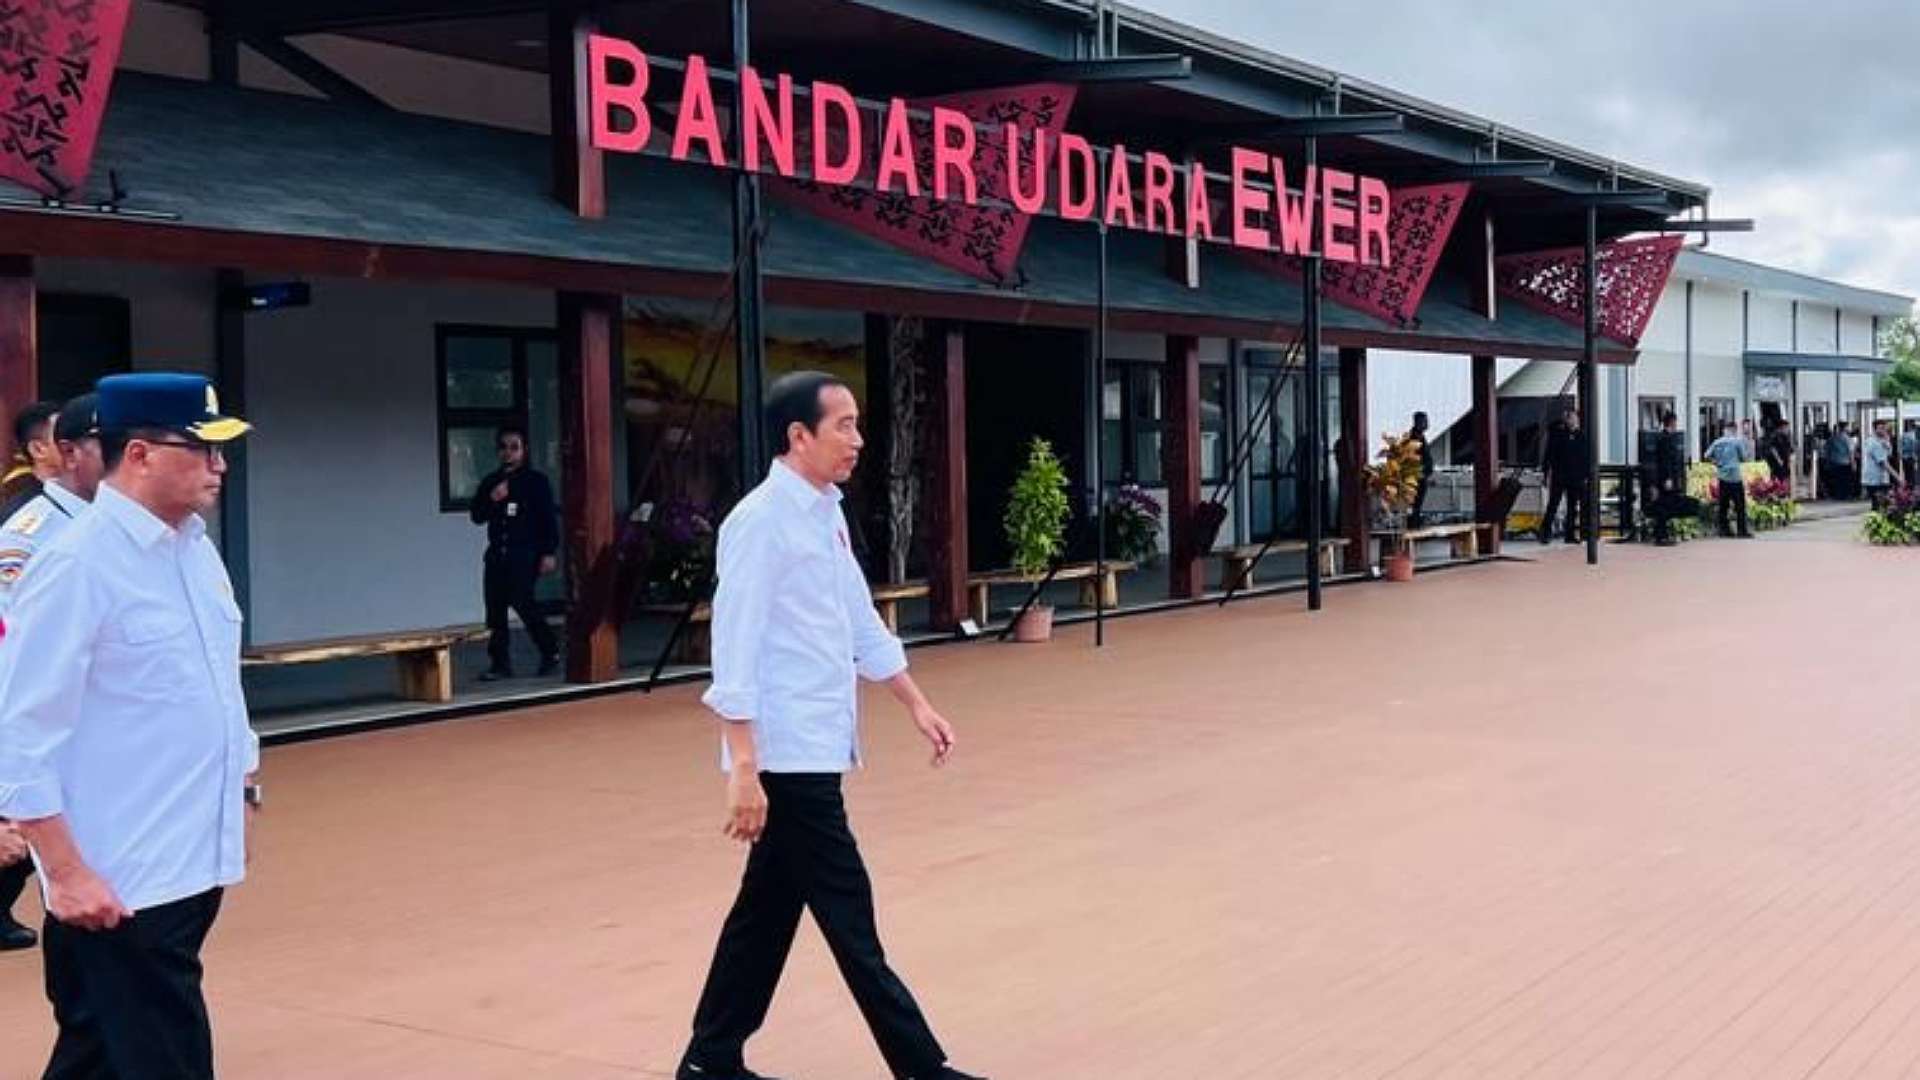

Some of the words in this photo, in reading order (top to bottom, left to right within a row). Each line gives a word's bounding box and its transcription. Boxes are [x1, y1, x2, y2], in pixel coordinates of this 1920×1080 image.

[588, 33, 978, 204] BANDAR
[1008, 124, 1213, 240] UDARA
[1231, 147, 1391, 266] EWER
